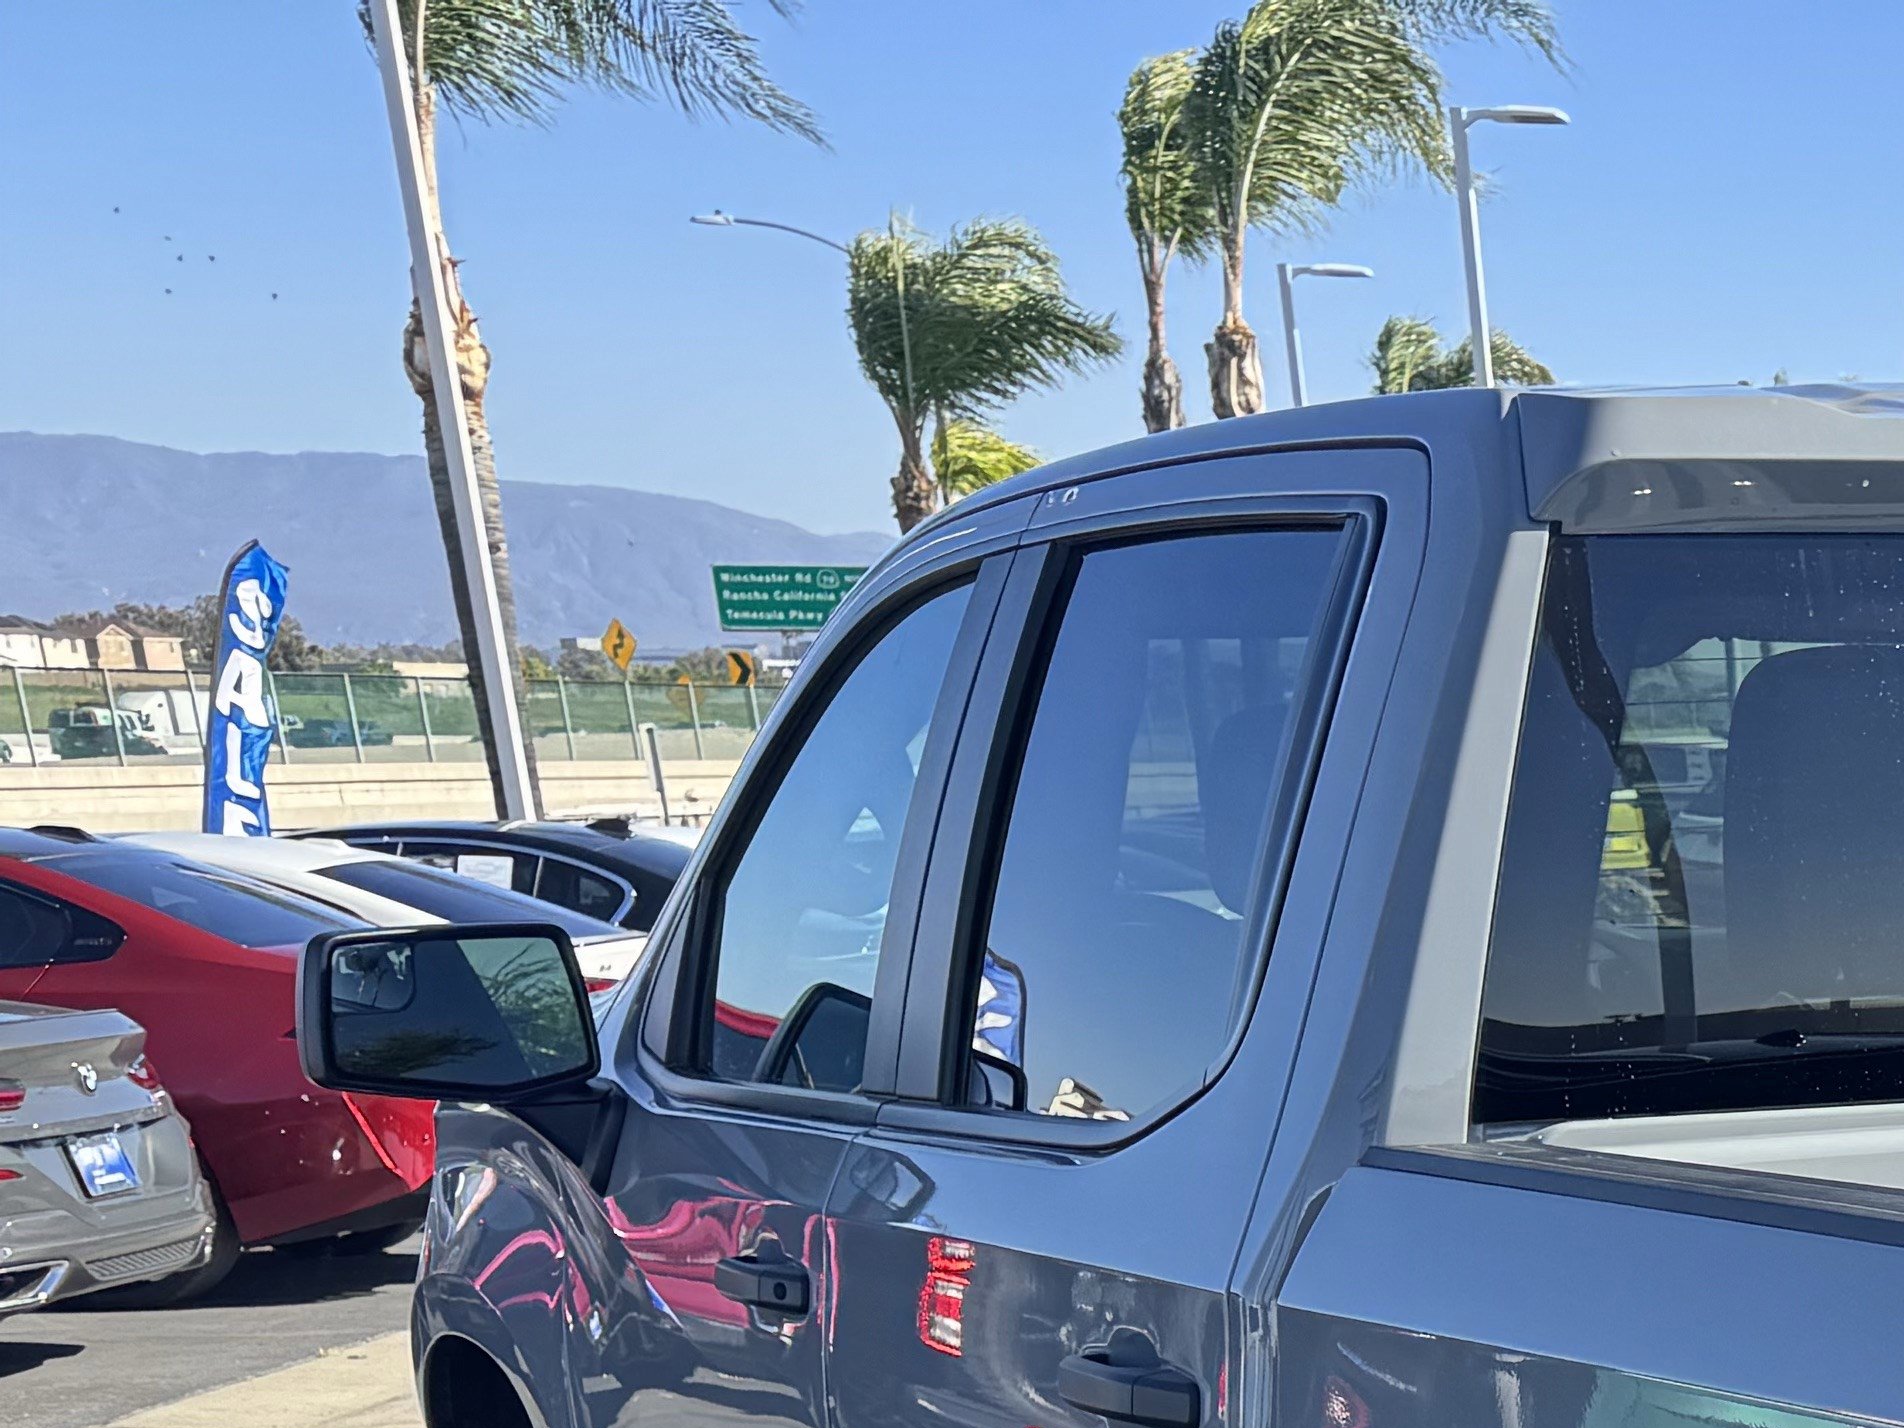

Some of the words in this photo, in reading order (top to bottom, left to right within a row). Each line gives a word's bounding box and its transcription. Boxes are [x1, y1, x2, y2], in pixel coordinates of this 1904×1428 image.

[720, 572, 790, 583] Winchester
[795, 572, 812, 583] Rd
[723, 590, 769, 601] Rancho
[773, 590, 836, 601] California
[726, 609, 786, 620] Temecula
[789, 610, 824, 622] Pkwy
